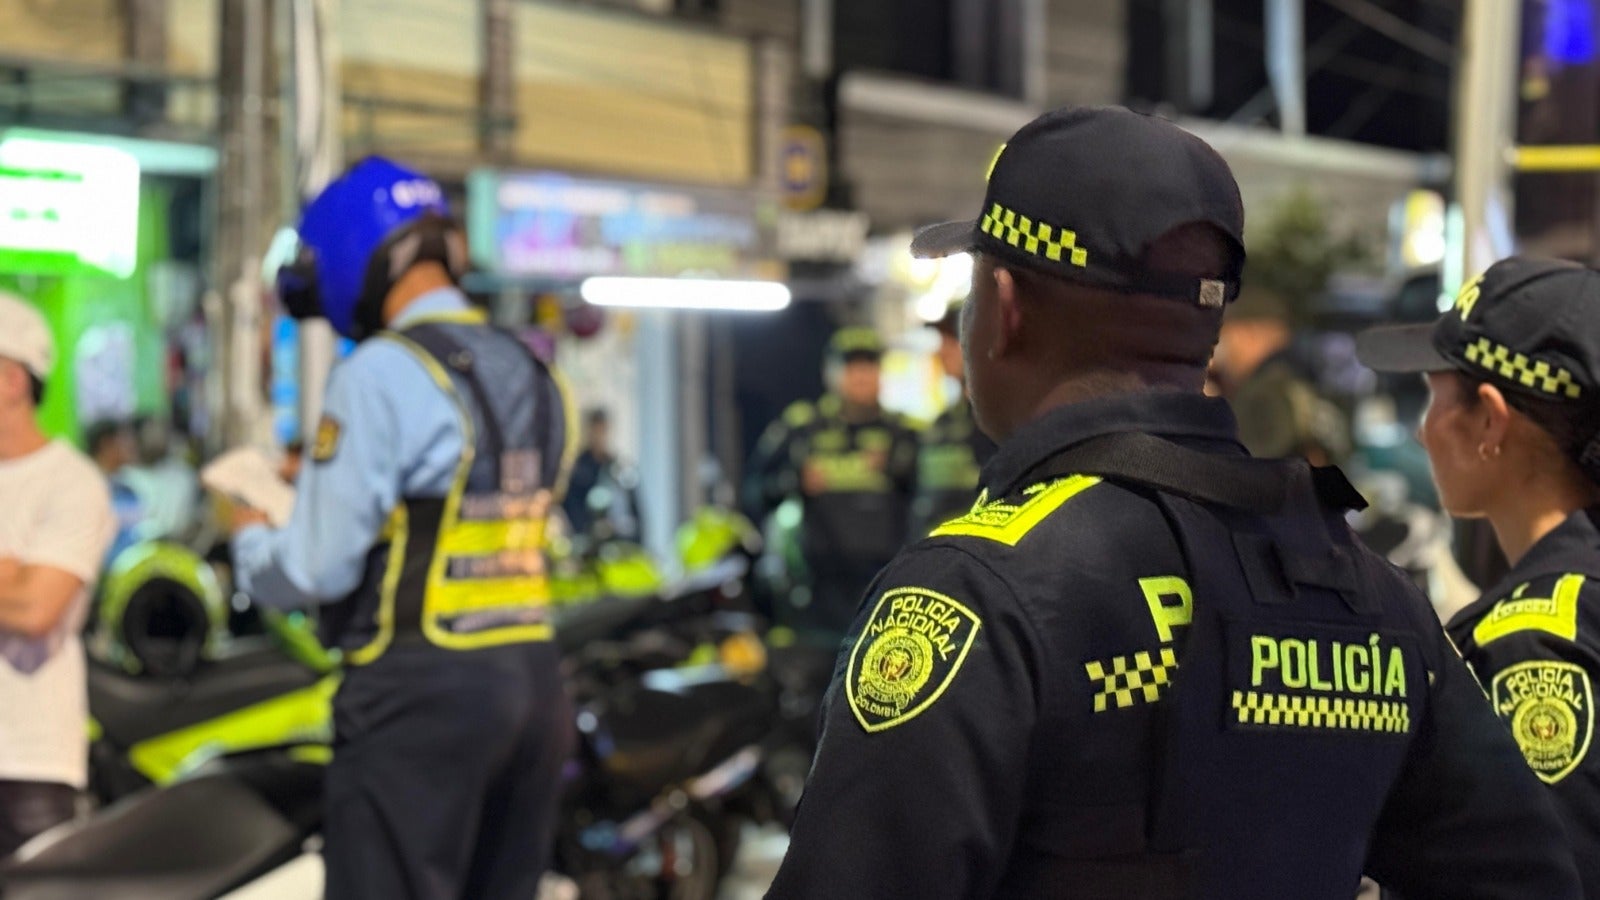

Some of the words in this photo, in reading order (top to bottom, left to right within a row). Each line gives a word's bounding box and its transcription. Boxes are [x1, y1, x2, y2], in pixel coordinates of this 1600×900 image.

[870, 612, 956, 661] NACIONAL
[1251, 633, 1406, 697] POLICÍA
[855, 695, 901, 717] COLOMBIA
[1500, 683, 1582, 716] NACIONAL
